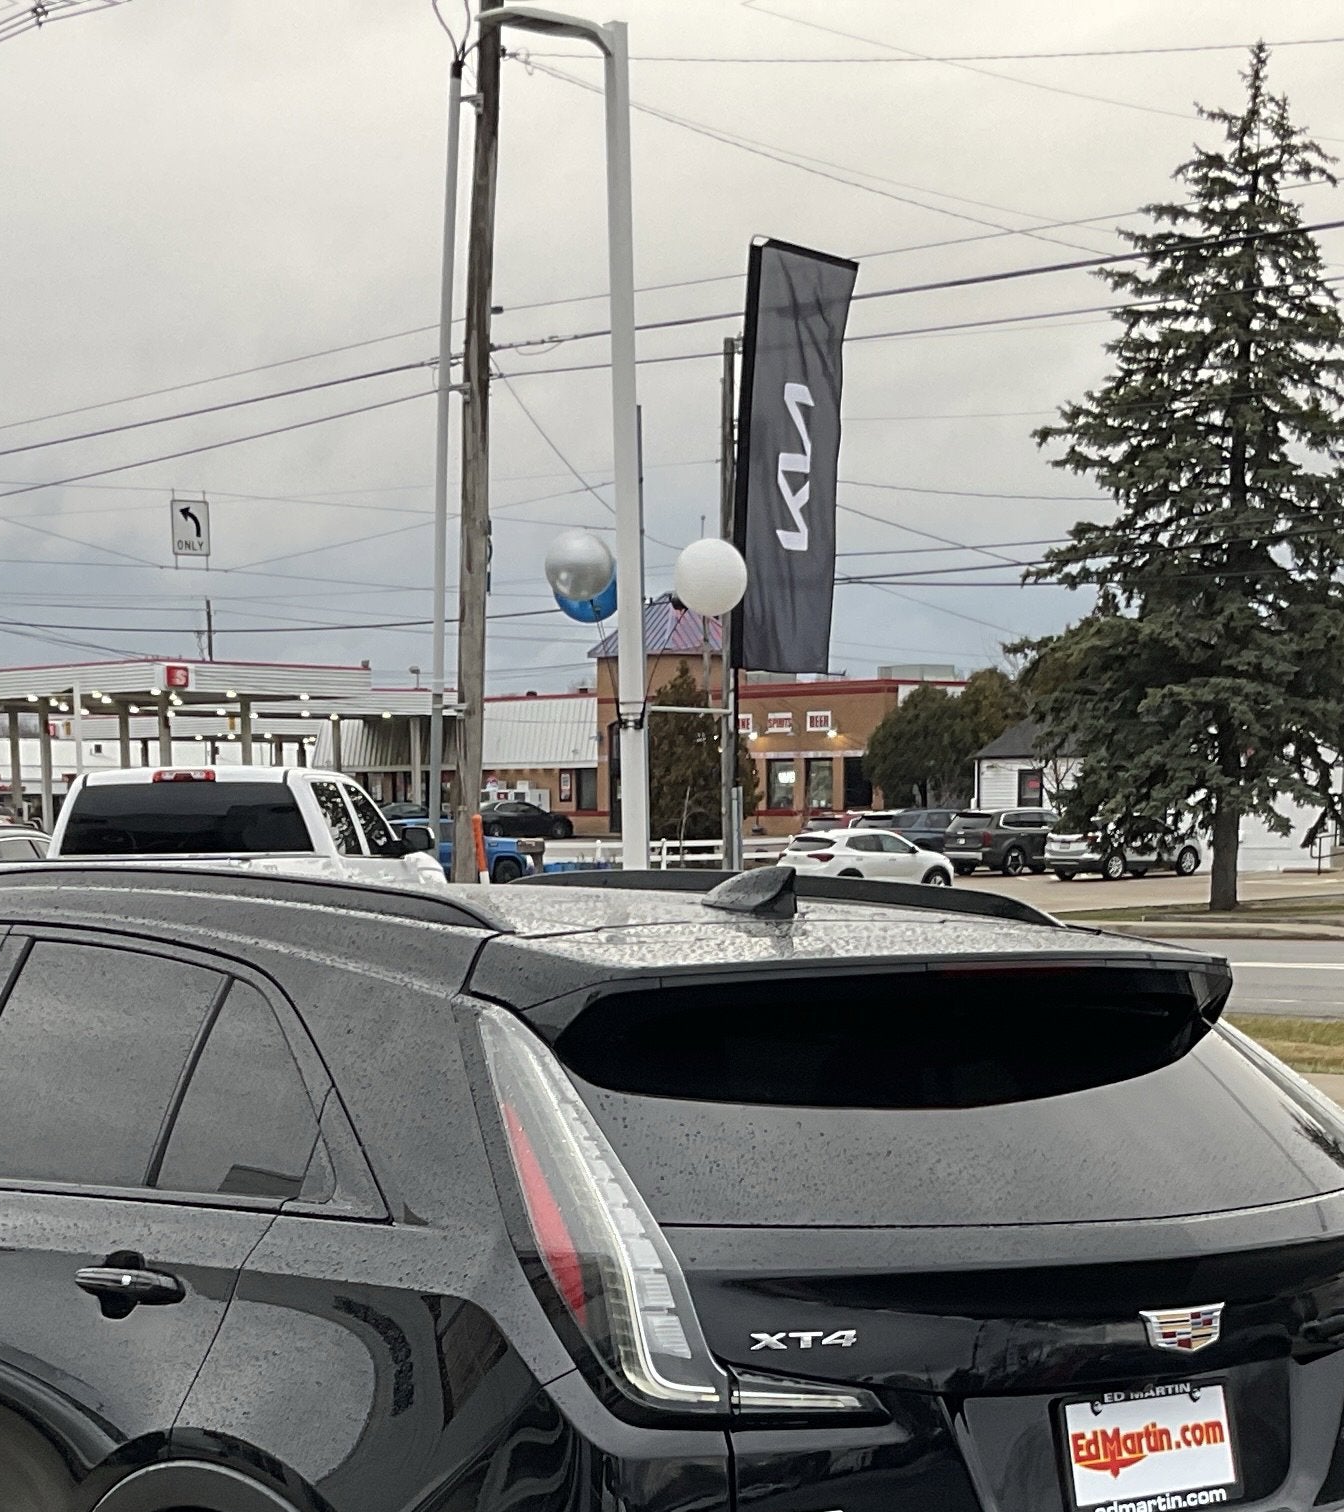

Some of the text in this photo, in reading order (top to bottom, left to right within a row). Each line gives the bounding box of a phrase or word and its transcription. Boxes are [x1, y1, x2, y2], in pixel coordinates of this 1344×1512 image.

[176, 539, 204, 552] ONLY
[809, 715, 829, 728] BEER
[750, 1329, 858, 1350] XT4
[1103, 1383, 1191, 1404] ED MARTIN
[1070, 1420, 1225, 1464] EdMartin.com
